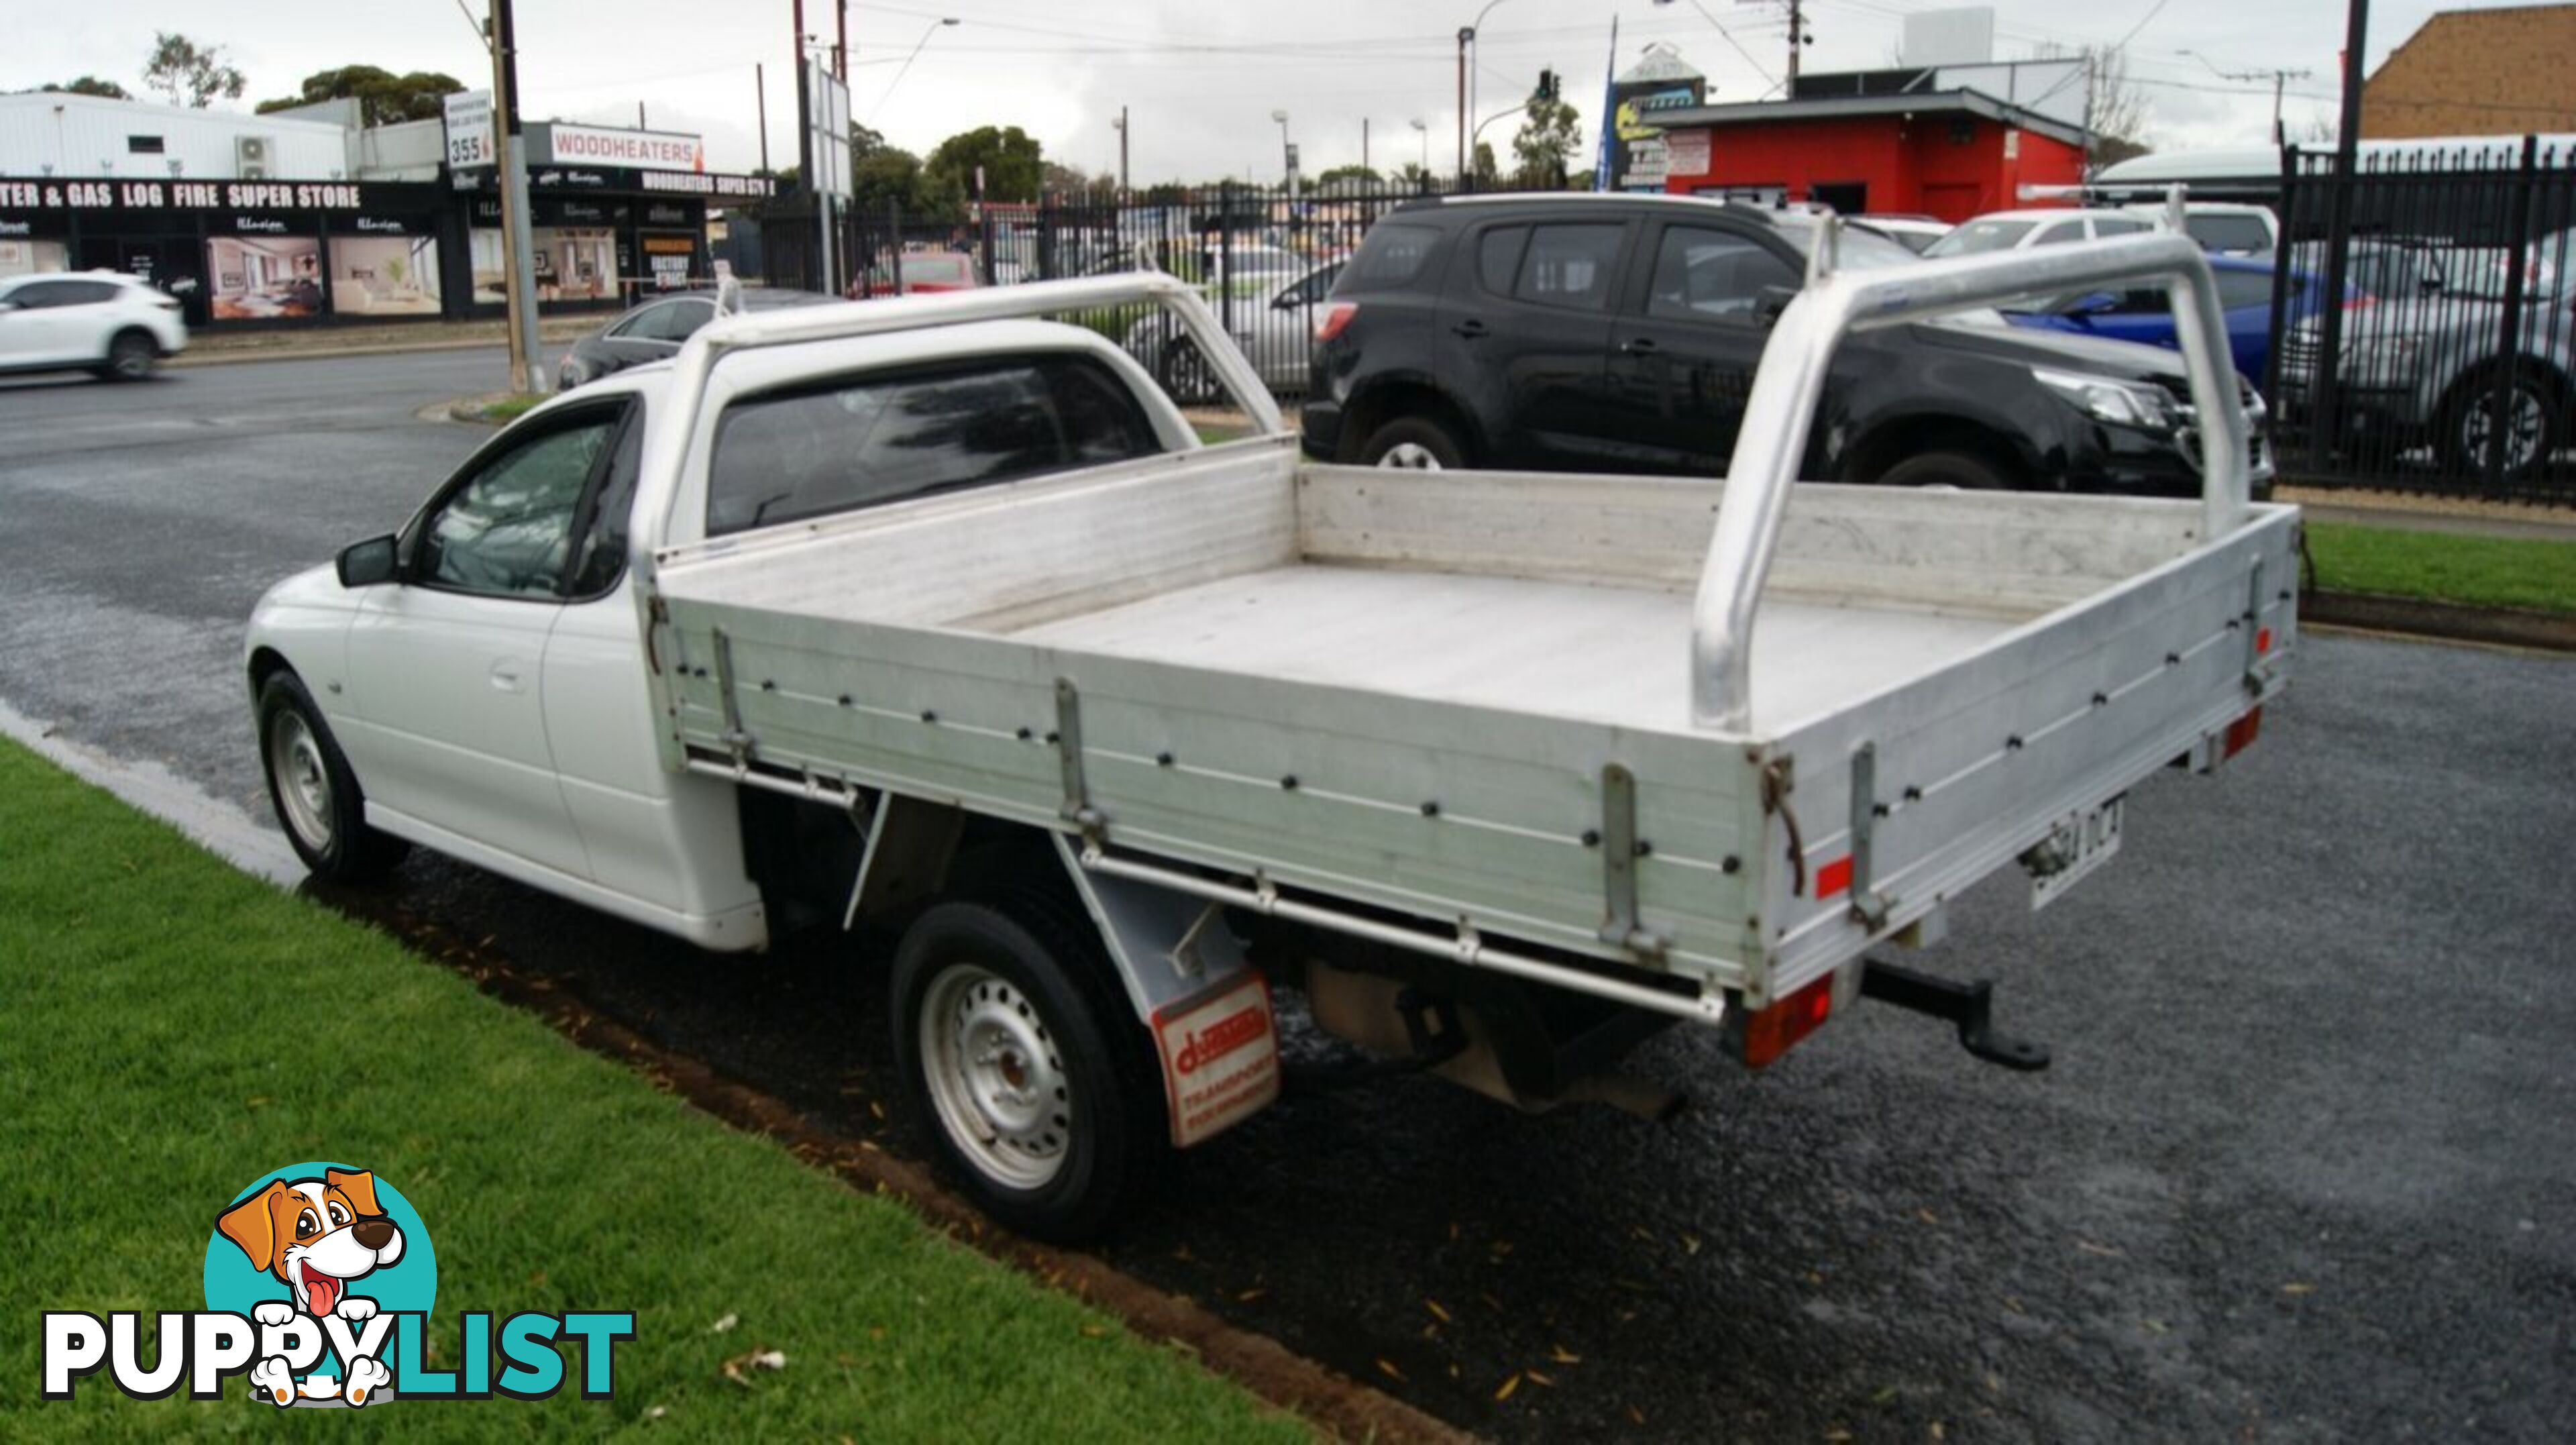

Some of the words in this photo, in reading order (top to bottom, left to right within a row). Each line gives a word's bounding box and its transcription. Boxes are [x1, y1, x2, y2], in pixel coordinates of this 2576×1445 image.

[451, 137, 480, 162] 355
[555, 133, 693, 162] WOODHEATERS
[46, 186, 63, 207] &
[67, 182, 112, 207] GAS
[122, 183, 164, 207] LOG
[173, 183, 219, 207] FIRE
[228, 184, 293, 208] SUPER
[297, 184, 360, 208] STORE
[642, 171, 714, 193] WOODHEATERS
[716, 175, 745, 195] SUPER
